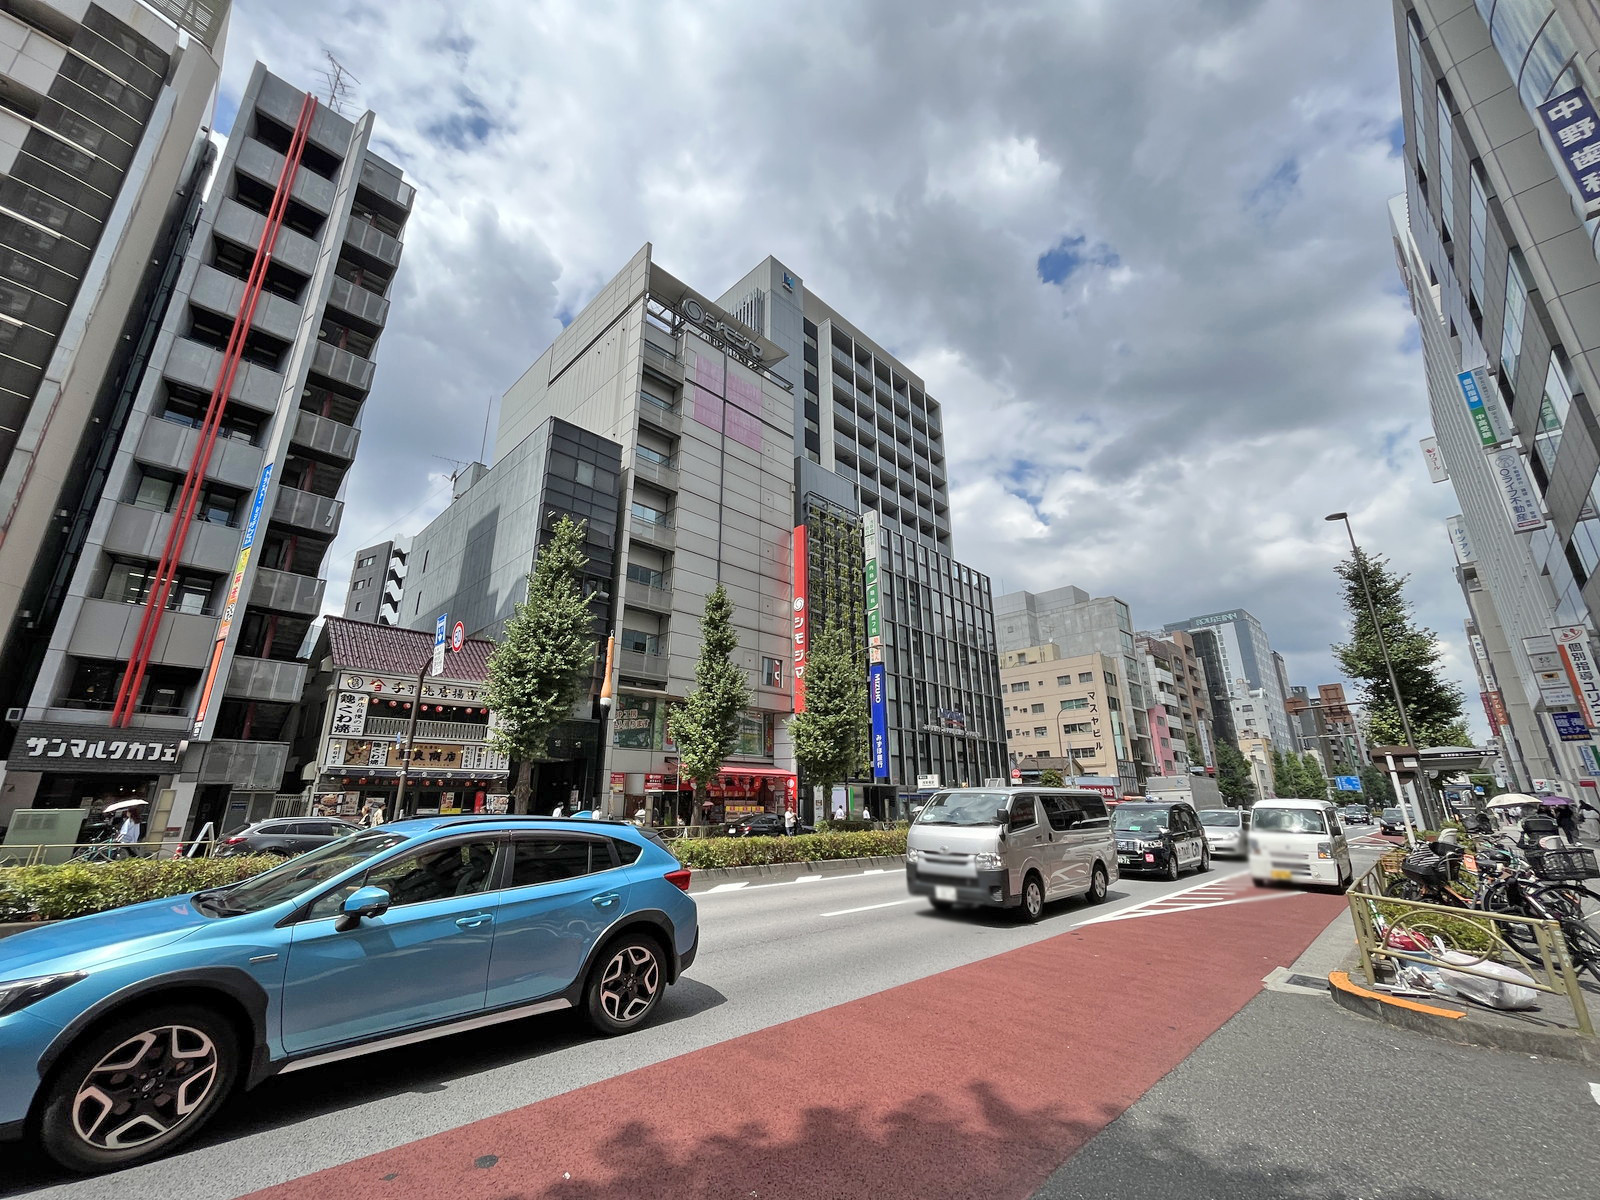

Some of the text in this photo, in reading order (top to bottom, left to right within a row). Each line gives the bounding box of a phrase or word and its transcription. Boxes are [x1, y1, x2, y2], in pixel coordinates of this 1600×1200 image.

[794, 616, 805, 680] シモジマ
[26, 737, 176, 762] サンマルクカフェ
[1087, 691, 1103, 751] マスヤビル
